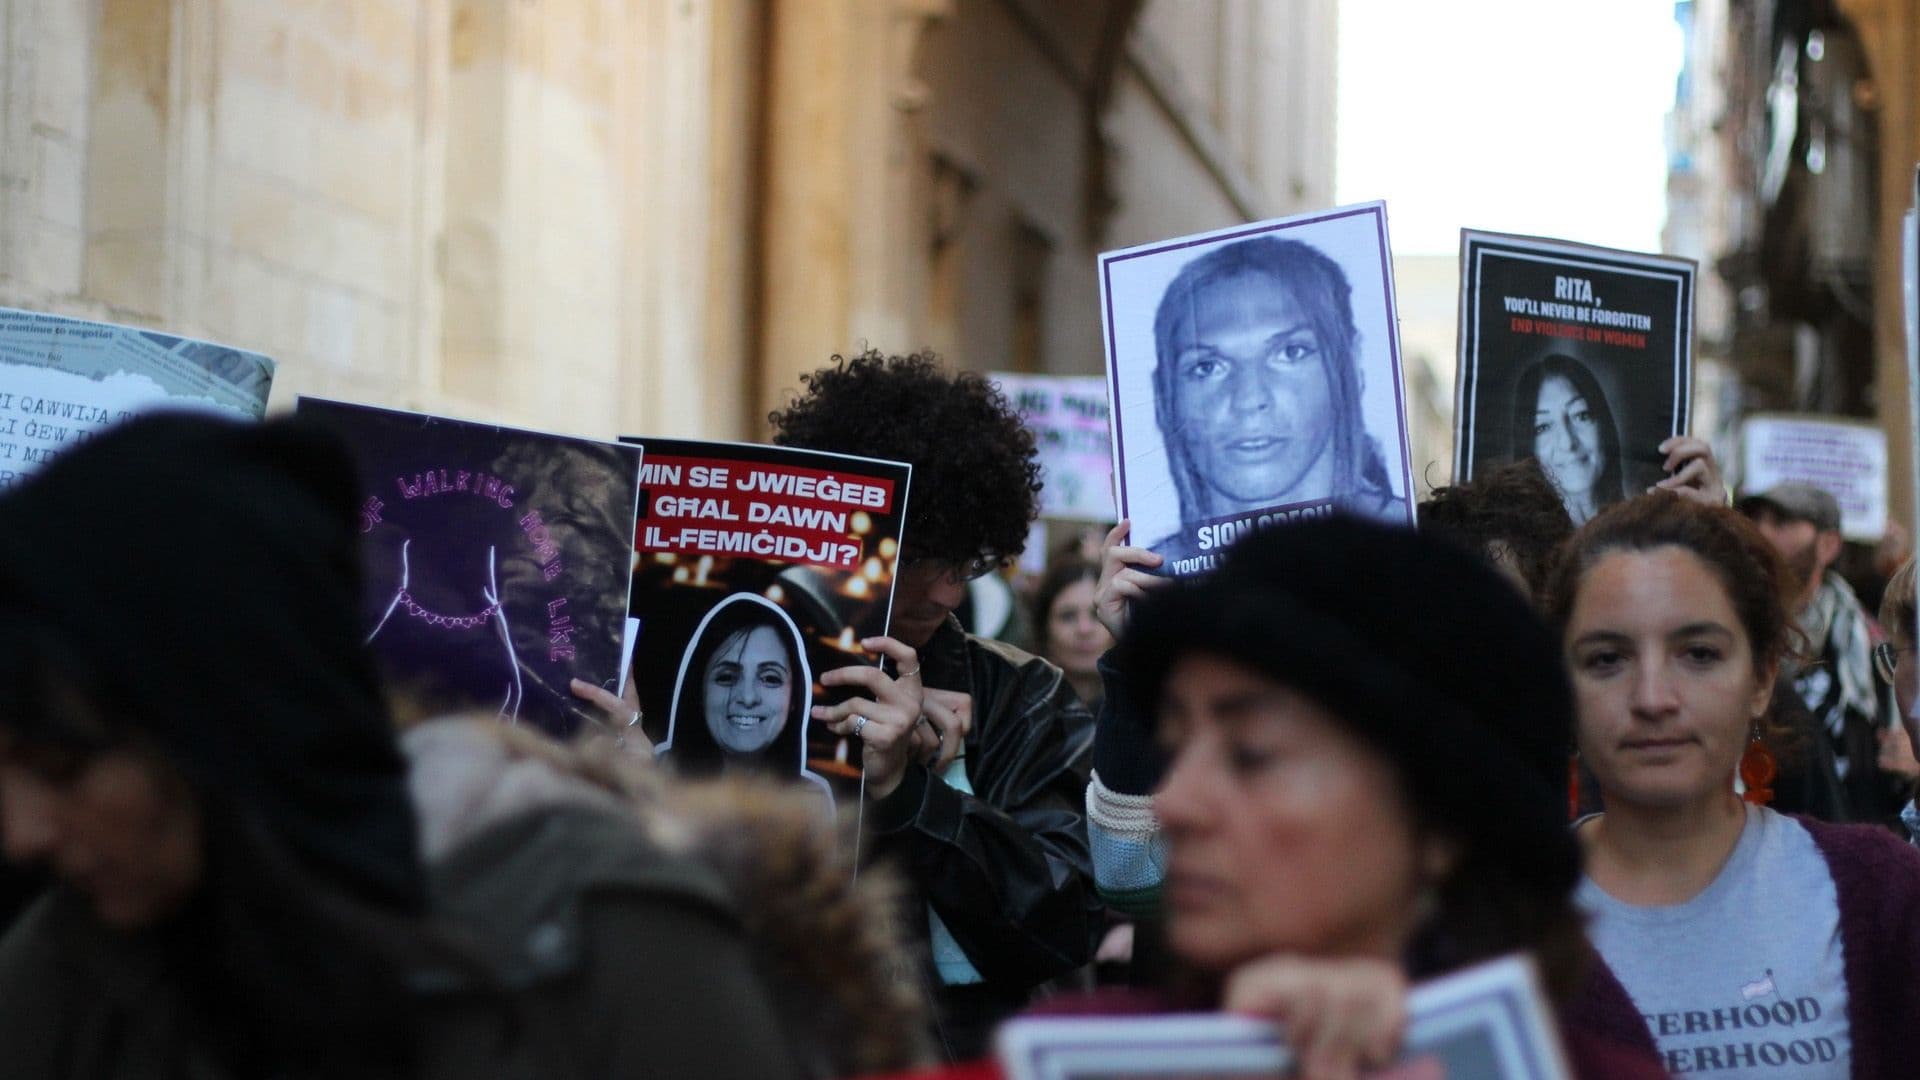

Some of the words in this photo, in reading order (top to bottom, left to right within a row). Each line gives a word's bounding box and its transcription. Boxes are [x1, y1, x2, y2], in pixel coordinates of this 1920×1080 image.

[1504, 297, 1538, 314] YOU'LL
[1541, 303, 1574, 320] NEVER
[1577, 309, 1590, 322] BE
[1592, 310, 1651, 331] FORGOTTEN
[1511, 318, 1532, 333] END
[1536, 321, 1584, 340] VIOLENCE
[1587, 328, 1600, 342] ON
[1604, 331, 1645, 348] WOMEN
[21, 397, 109, 424] QAWWIJA
[689, 466, 729, 489] SE
[736, 471, 886, 508] JWIEĠEB
[748, 501, 846, 534] DAWN
[644, 526, 858, 566] IL-FEMIĊIDJI?
[397, 469, 515, 508] WALKING
[519, 509, 562, 582] HOME
[547, 597, 575, 662] LIKE
